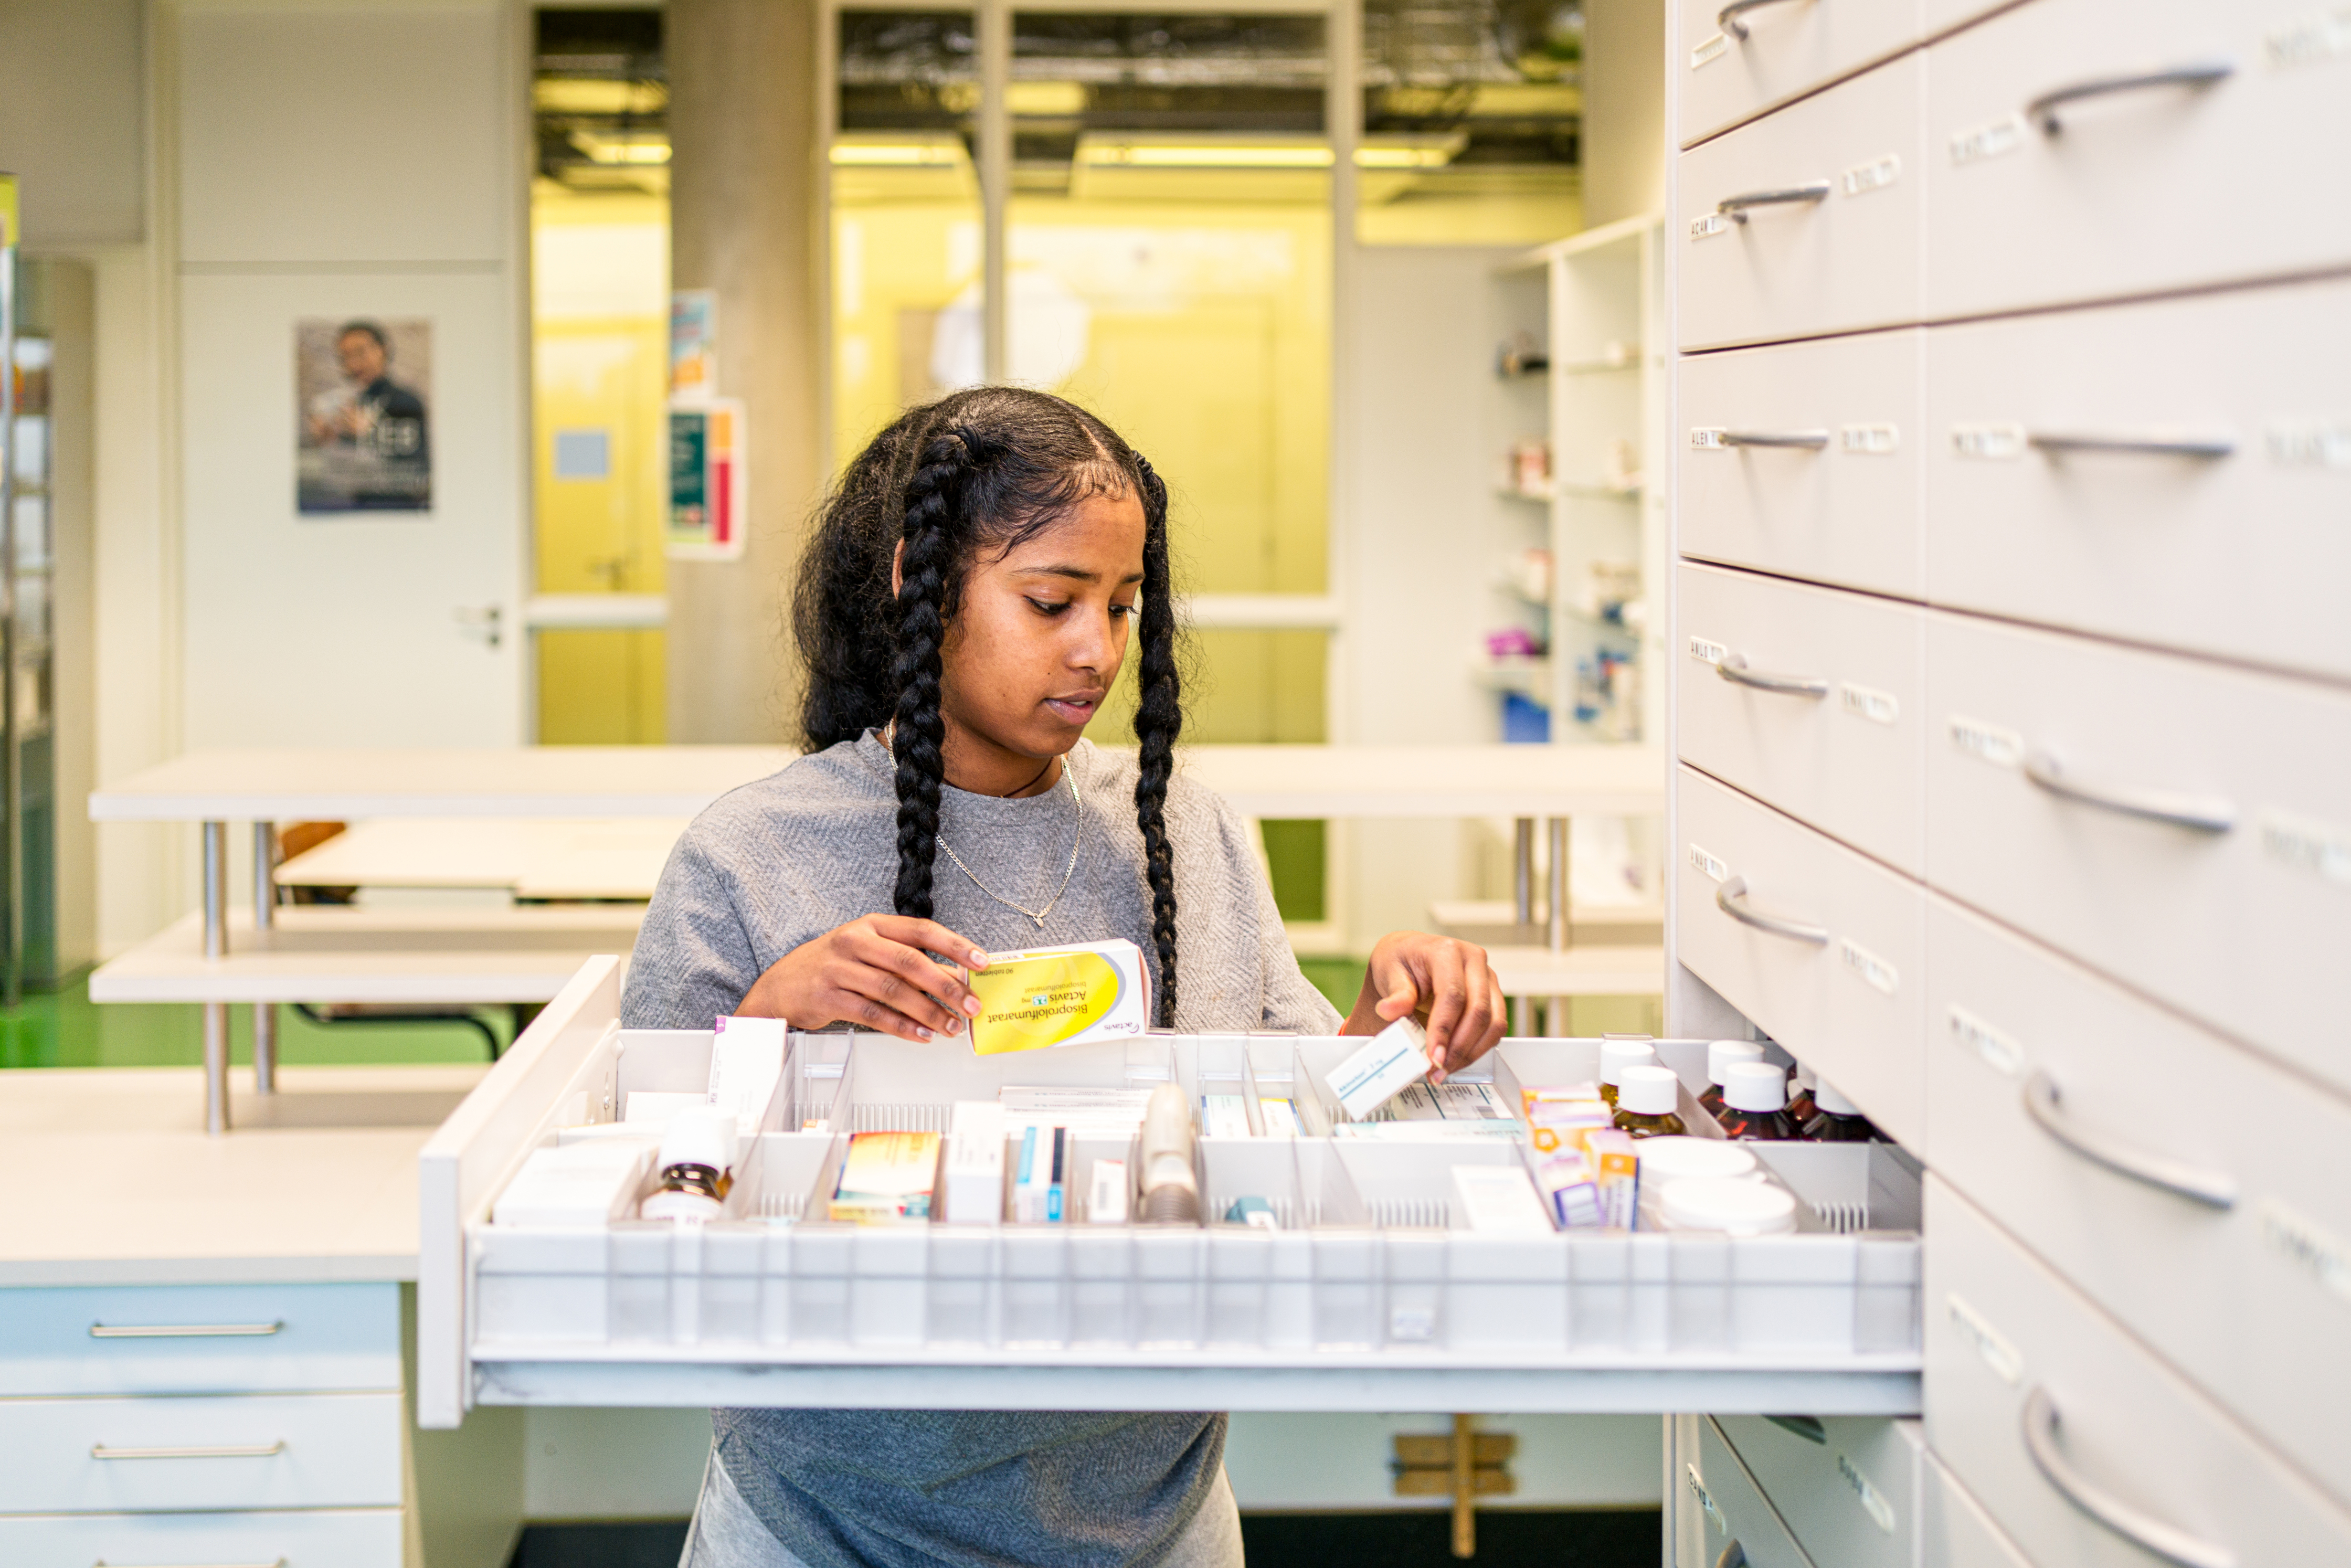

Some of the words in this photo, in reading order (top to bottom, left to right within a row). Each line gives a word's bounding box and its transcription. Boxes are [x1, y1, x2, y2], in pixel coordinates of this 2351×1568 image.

[1024, 981, 1087, 993] bisoprololfumaraat
[1033, 995, 1047, 1005] 2,5
[1050, 991, 1086, 1003] Actavis
[987, 1004, 1088, 1023] Bisoprololfumaraat
[1104, 1022, 1132, 1031] actavis
